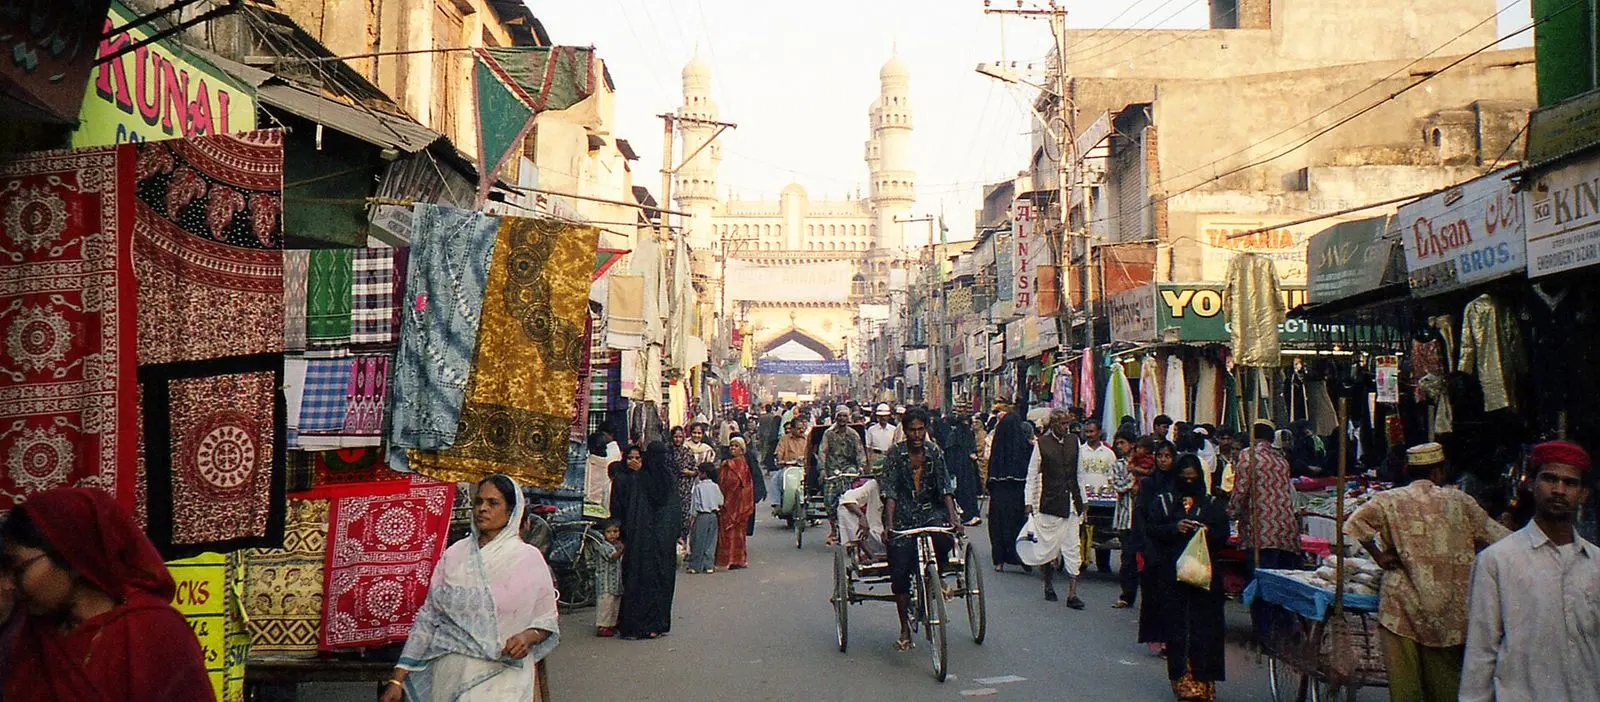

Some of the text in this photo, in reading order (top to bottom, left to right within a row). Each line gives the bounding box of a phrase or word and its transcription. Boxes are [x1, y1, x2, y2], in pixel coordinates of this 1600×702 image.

[1206, 229, 1293, 249] TAPARIA
[1413, 217, 1473, 260] Ehsan
[1015, 205, 1030, 309] ALNISA
[1460, 242, 1515, 274] BROS.
[176, 580, 209, 605] CKS
[204, 645, 217, 662] ts
